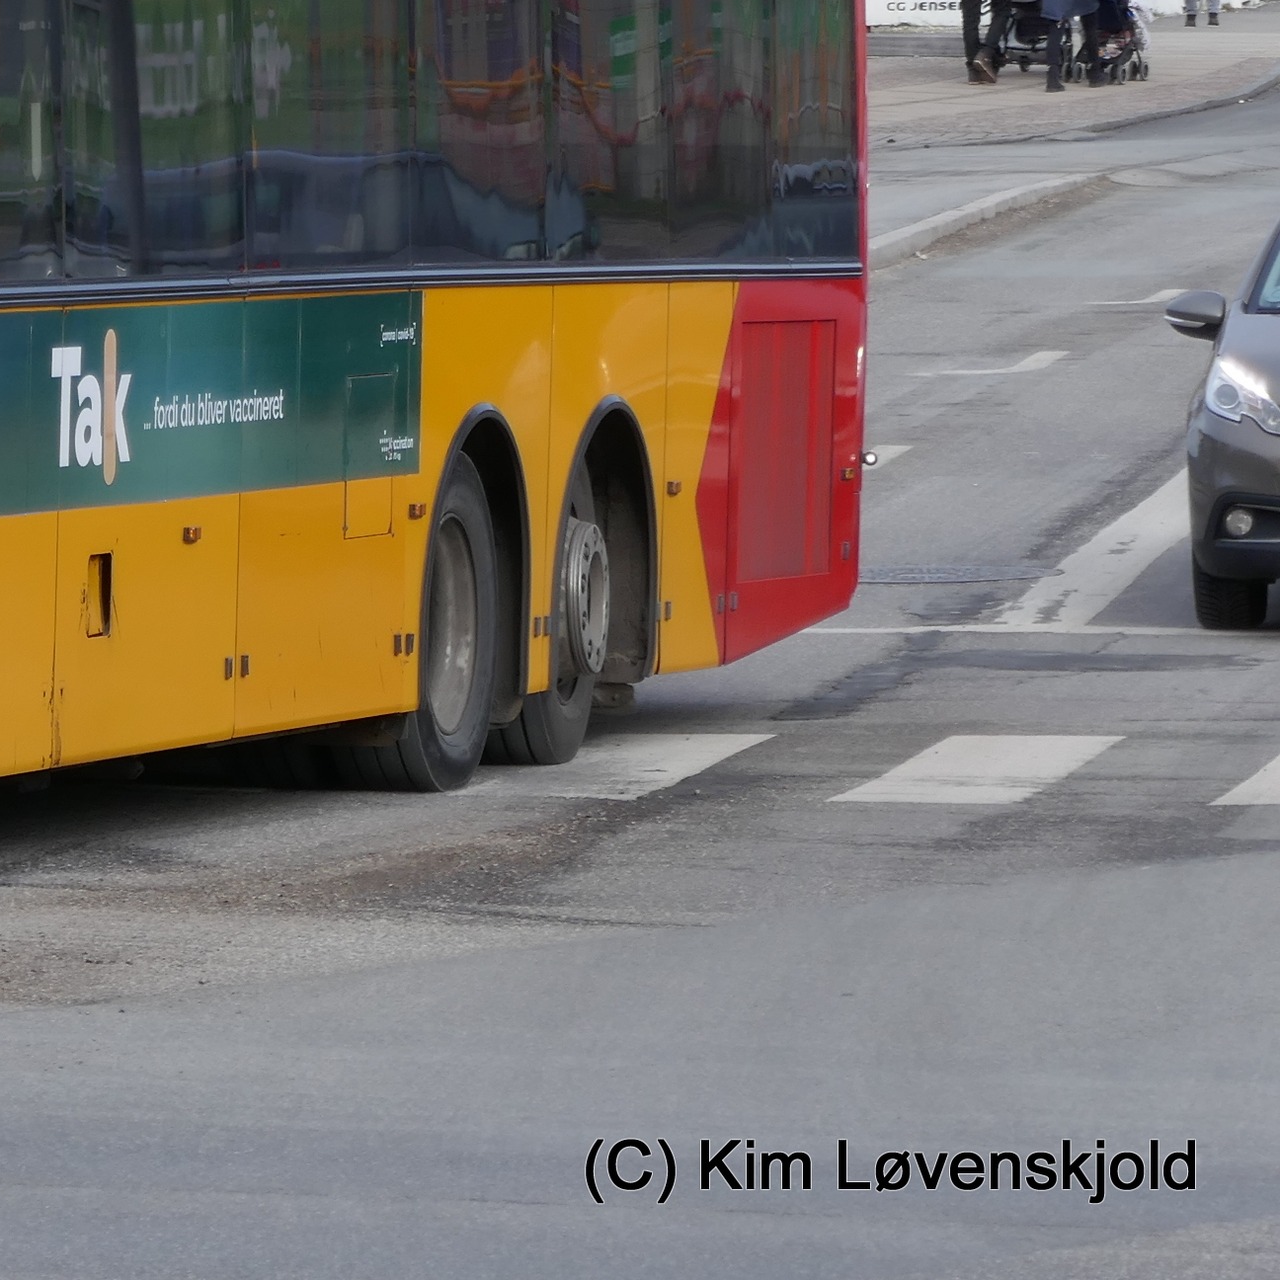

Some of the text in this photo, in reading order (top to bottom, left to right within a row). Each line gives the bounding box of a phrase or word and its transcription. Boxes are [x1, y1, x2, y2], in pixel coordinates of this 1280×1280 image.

[887, 1, 962, 12] CG JENSE
[154, 396, 178, 430] fordi
[181, 394, 195, 427] du
[197, 392, 228, 425] bliver
[229, 388, 285, 422] vaccineret
